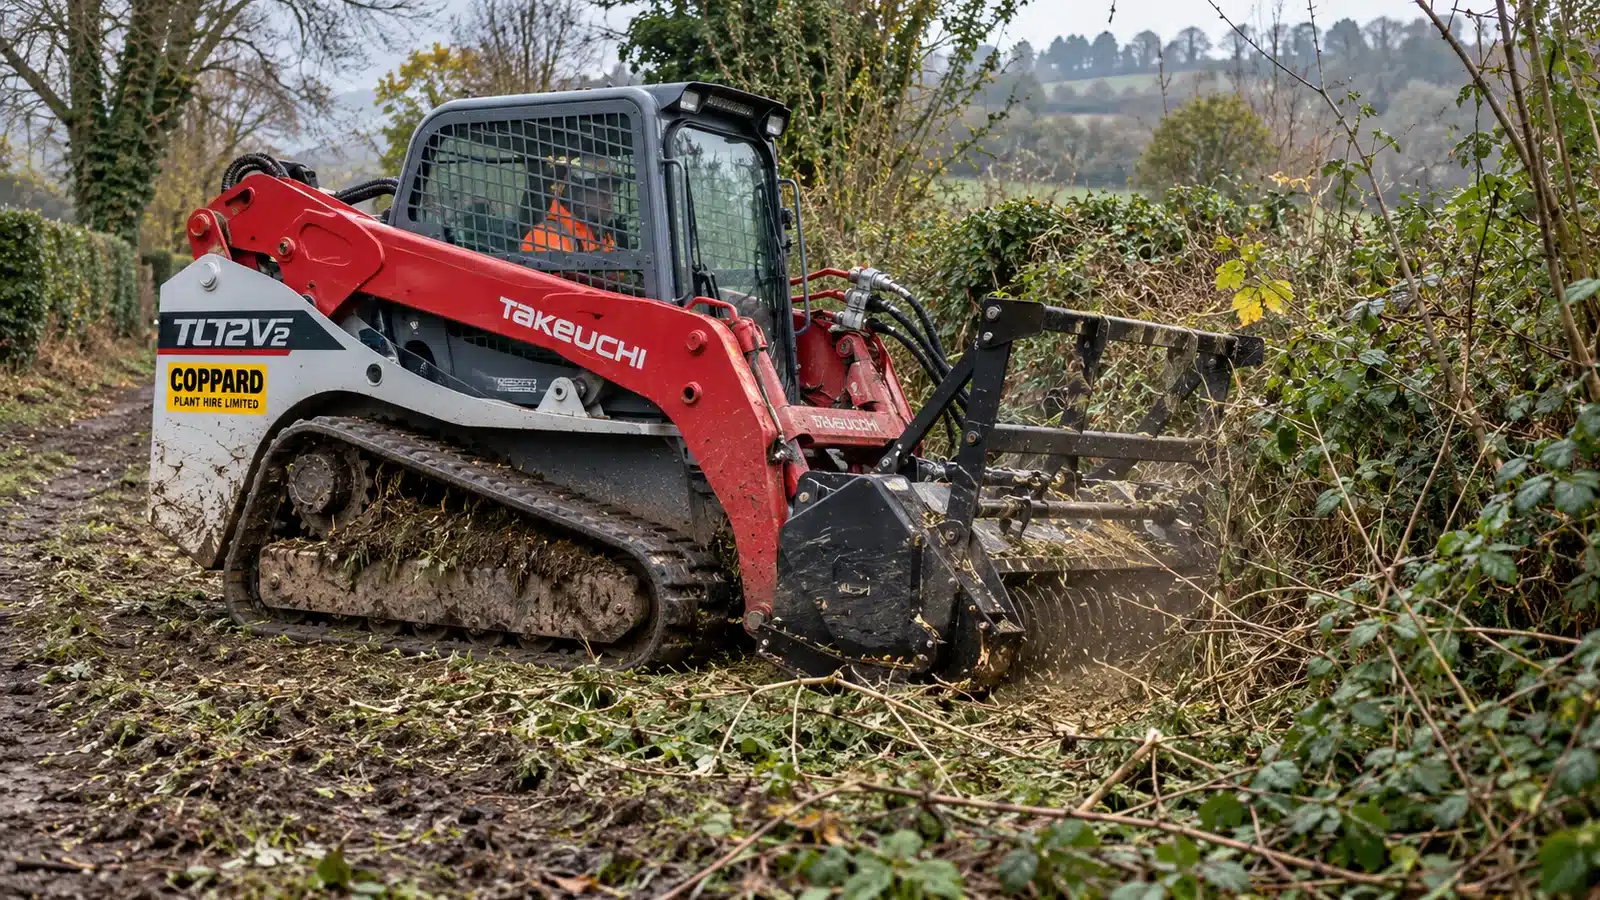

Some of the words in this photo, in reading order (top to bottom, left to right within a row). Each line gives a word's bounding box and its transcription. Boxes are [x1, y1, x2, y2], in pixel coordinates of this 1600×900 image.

[171, 367, 264, 393] COPPARD
[174, 396, 200, 407] PLANT
[203, 397, 222, 408] HIRE
[225, 399, 259, 409] LIMITED
